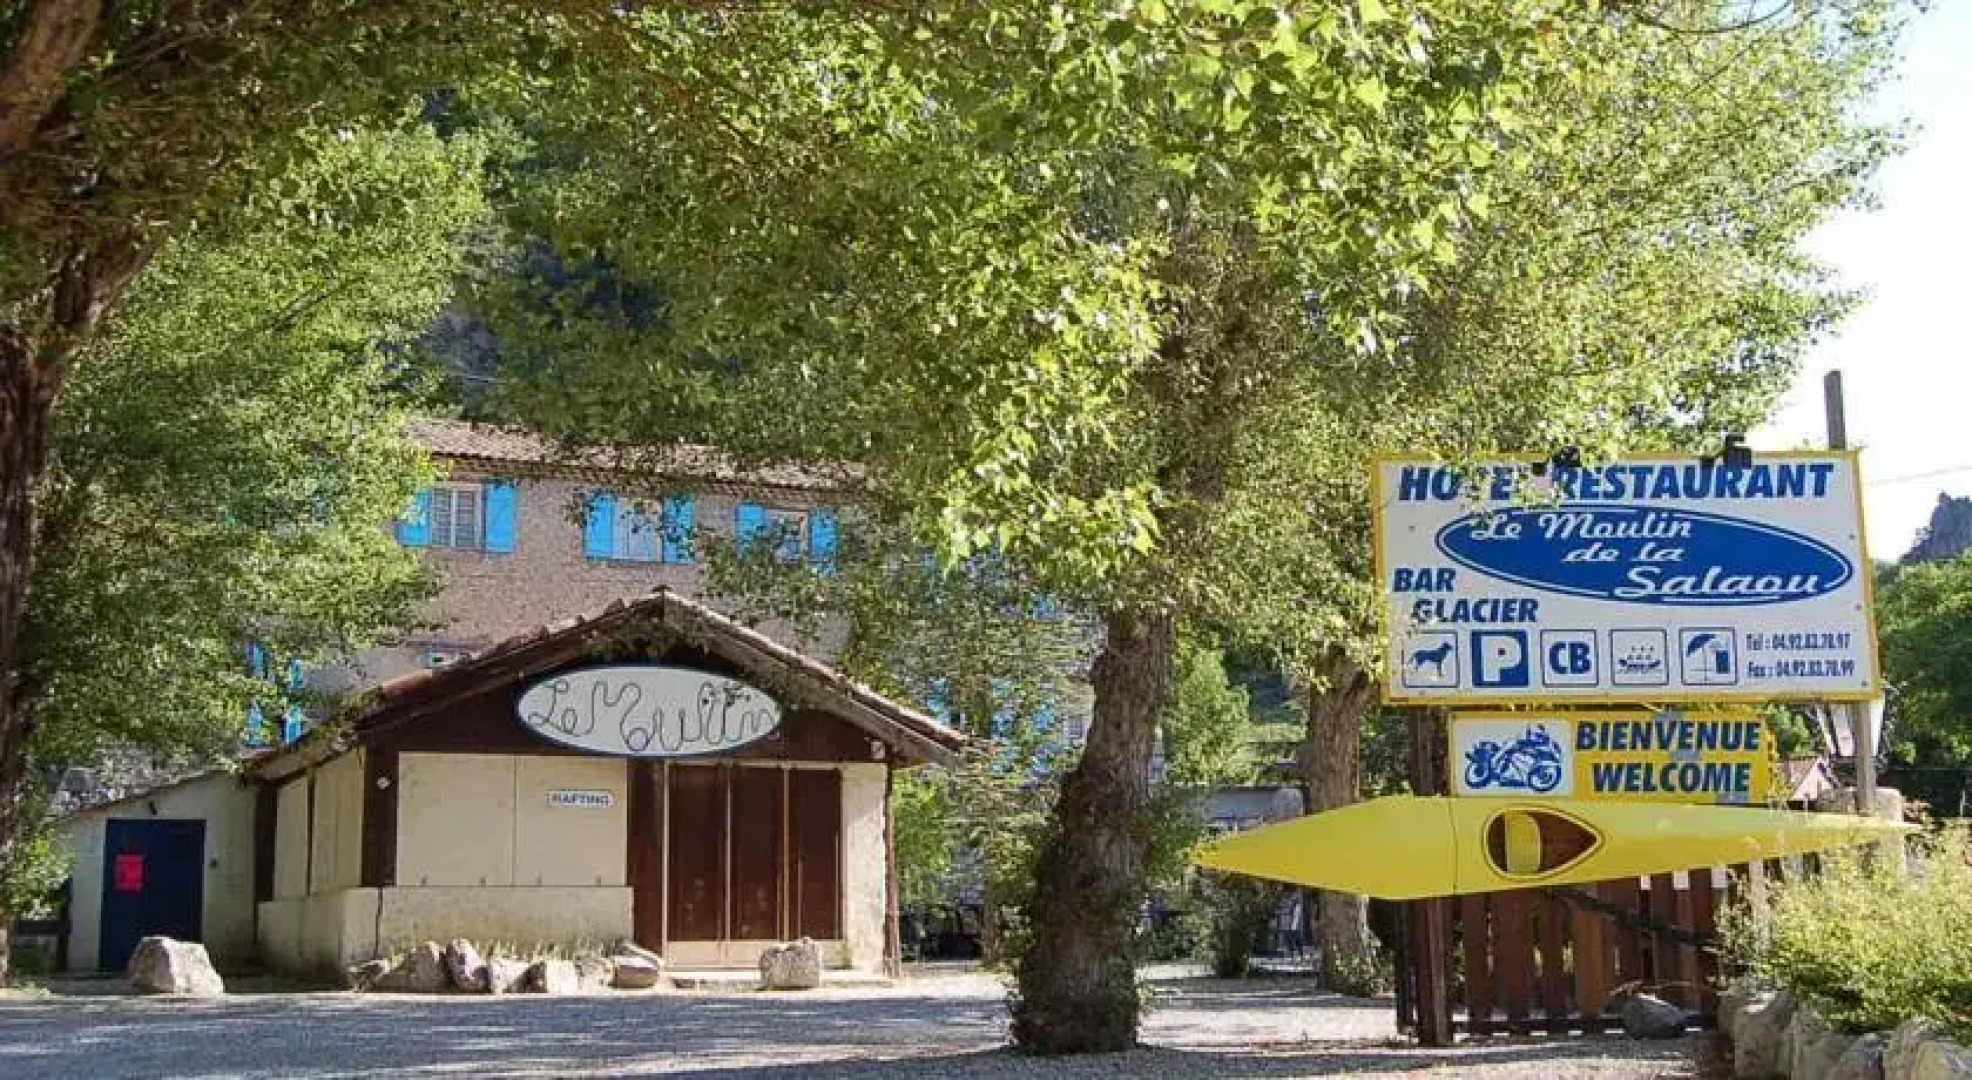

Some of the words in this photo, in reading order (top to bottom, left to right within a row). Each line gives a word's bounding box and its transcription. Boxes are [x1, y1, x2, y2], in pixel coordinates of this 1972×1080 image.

[1399, 466, 1531, 501] HOE
[1552, 463, 1834, 500] RESTAURANT
[1471, 513, 1522, 541] Le
[1538, 511, 1692, 540] Moulin
[1561, 542, 1620, 563] de
[1631, 542, 1686, 563] la
[1393, 567, 1457, 592] BAR
[1613, 565, 1820, 597] Salaou
[1411, 598, 1539, 623] GLACIER
[1548, 640, 1592, 675] CB
[1576, 719, 1762, 751] BIENVENUE
[1592, 761, 1752, 793] WELCOME
[551, 793, 610, 806] RAFTING
